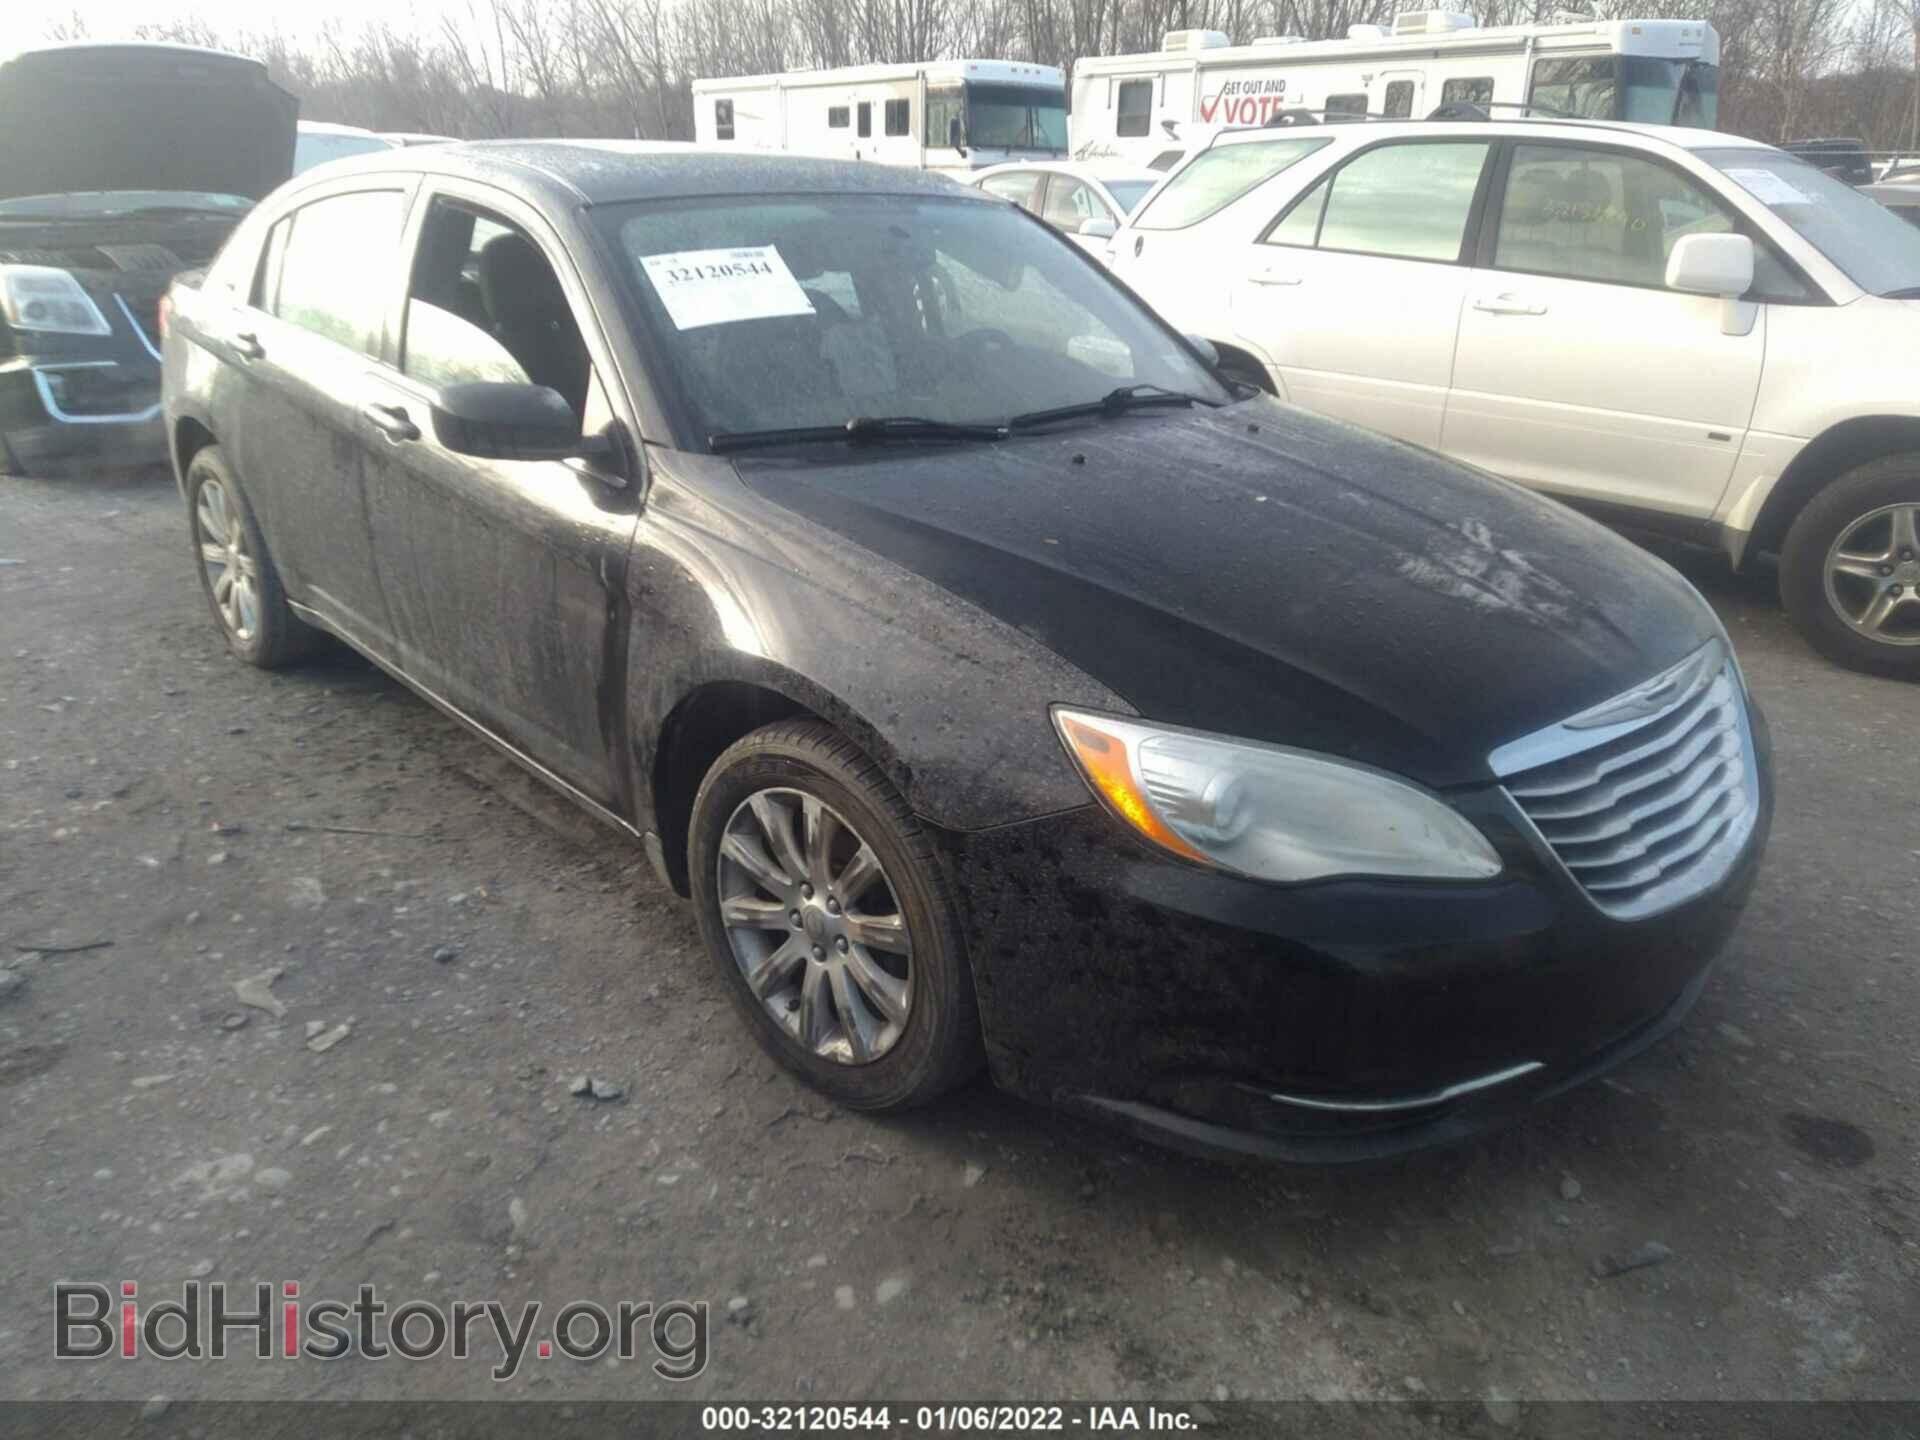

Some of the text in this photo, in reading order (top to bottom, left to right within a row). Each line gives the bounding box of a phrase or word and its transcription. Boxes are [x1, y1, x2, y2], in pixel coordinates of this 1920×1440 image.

[1224, 79, 1286, 95] GET OUT AND
[665, 261, 773, 283] 32120544
